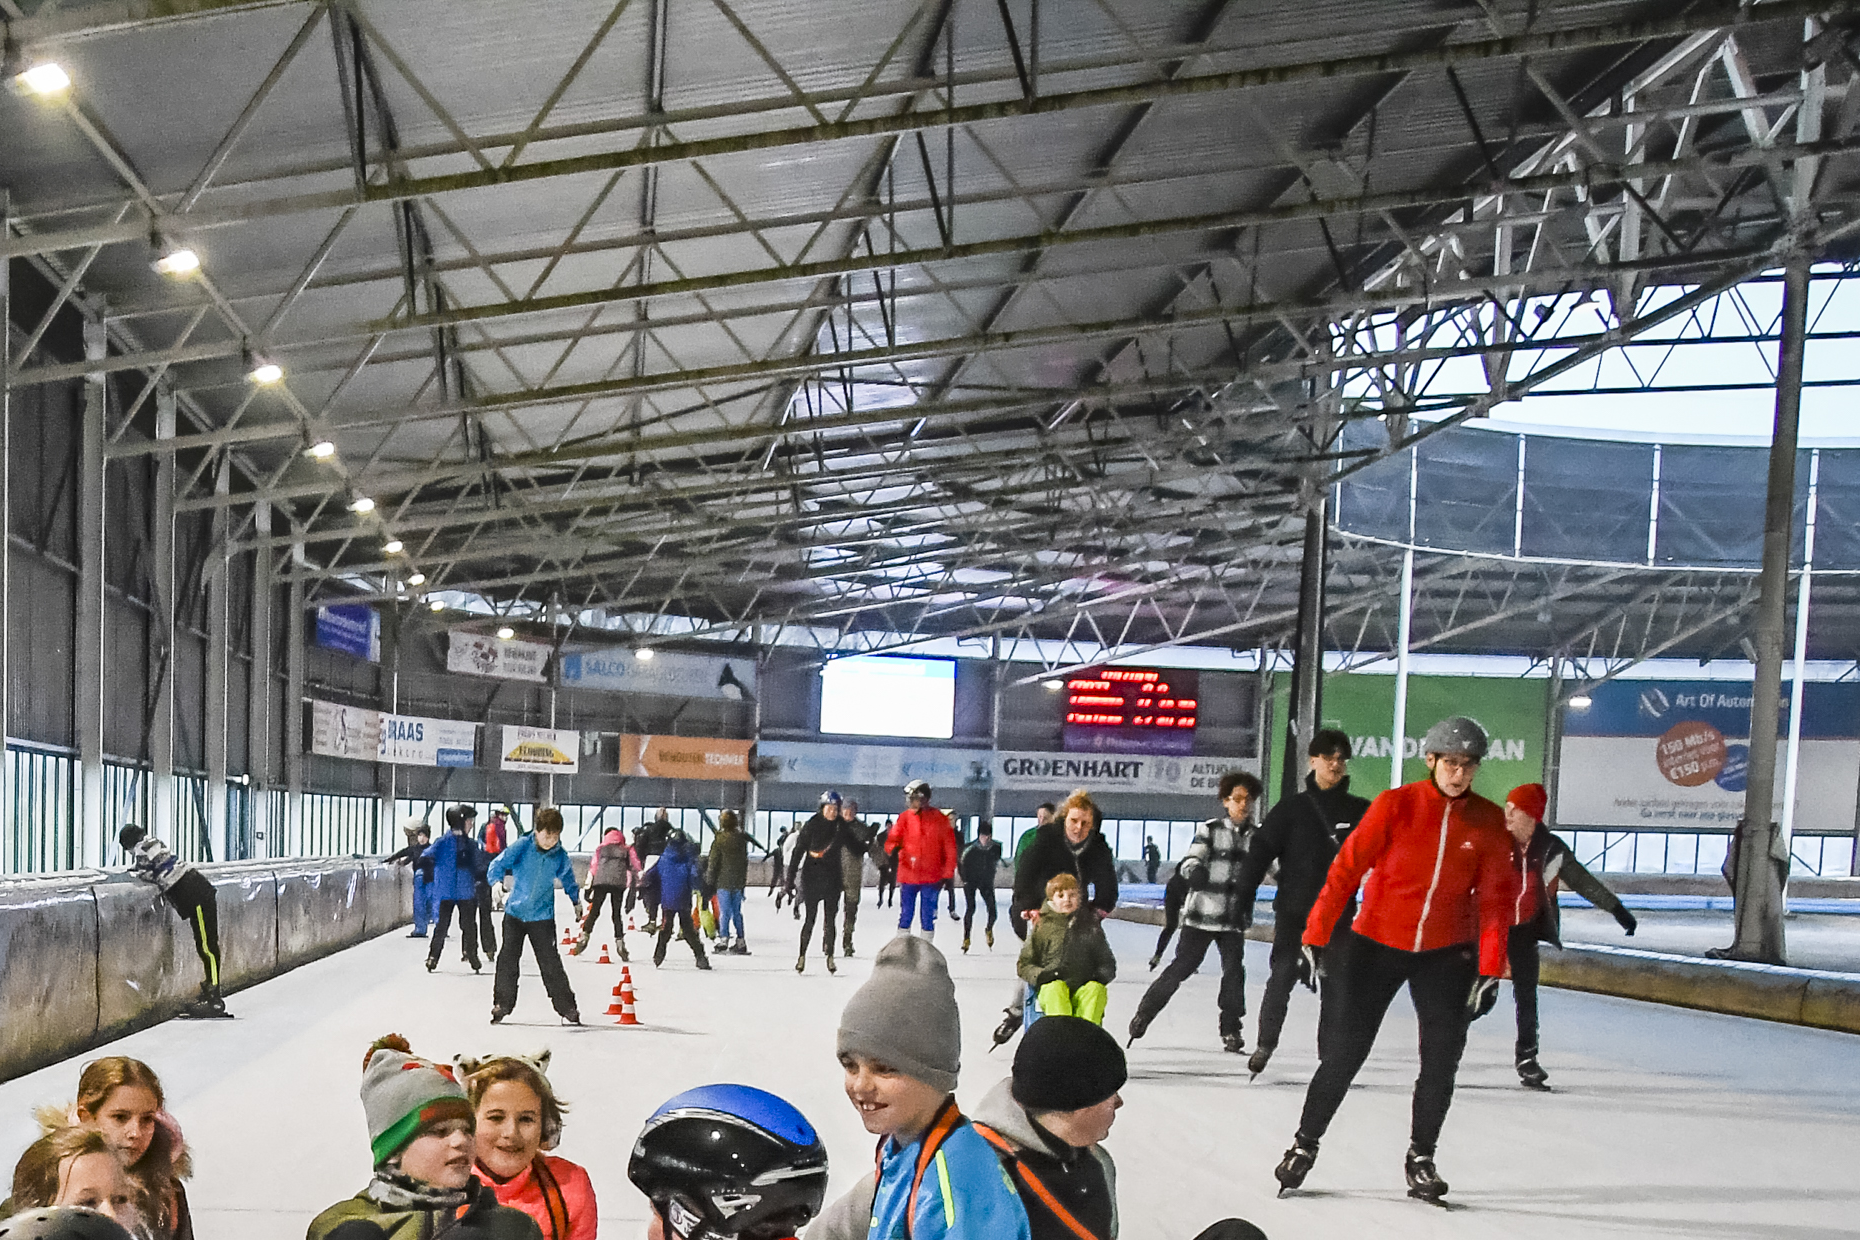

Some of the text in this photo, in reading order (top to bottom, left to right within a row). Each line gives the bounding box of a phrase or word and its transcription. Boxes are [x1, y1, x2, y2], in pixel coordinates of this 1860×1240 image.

[1676, 694, 1696, 707] Art
[1700, 694, 1715, 708] Of
[1003, 758, 1144, 779] GROENHART
